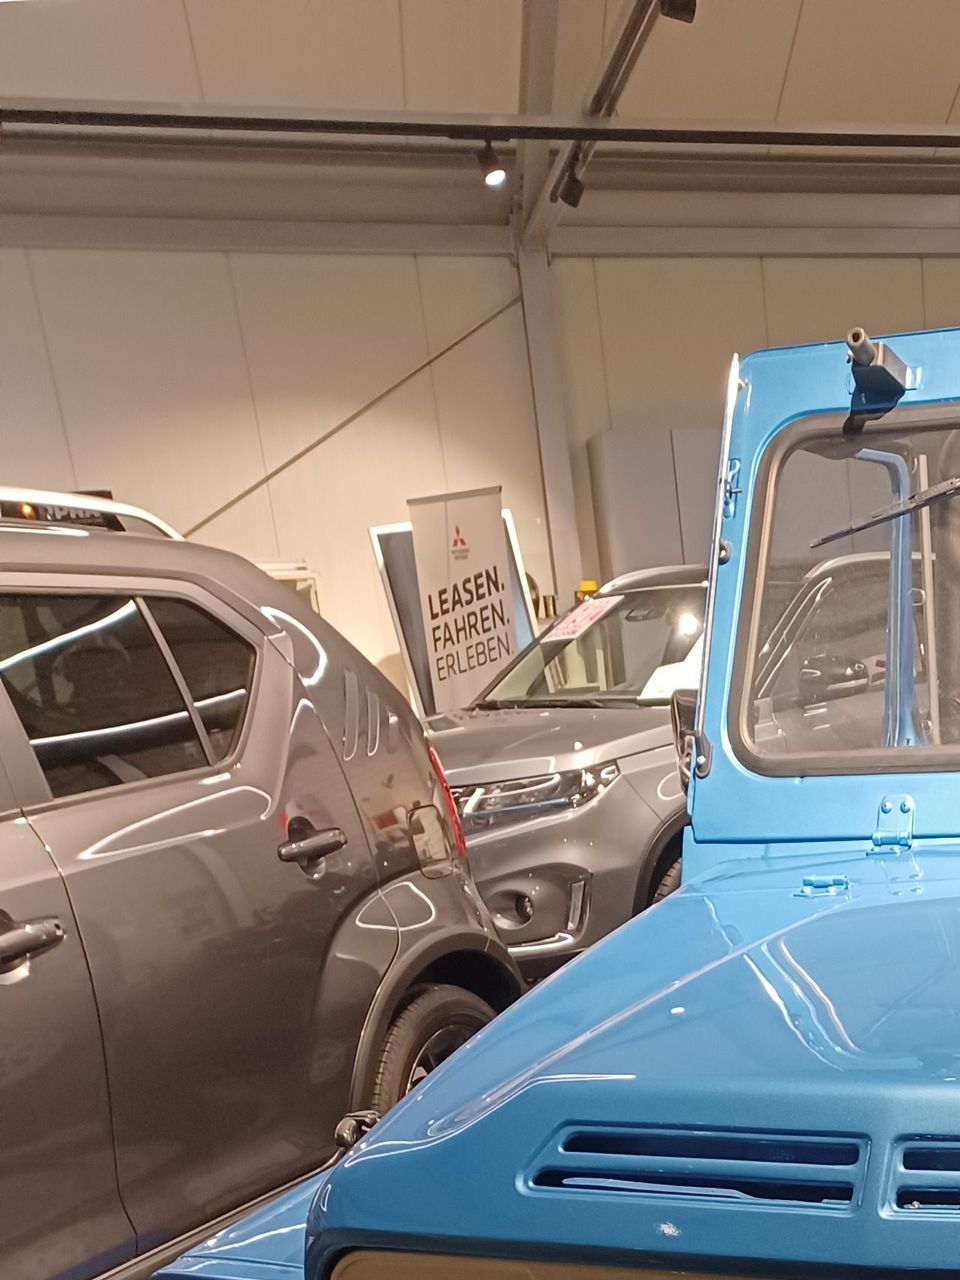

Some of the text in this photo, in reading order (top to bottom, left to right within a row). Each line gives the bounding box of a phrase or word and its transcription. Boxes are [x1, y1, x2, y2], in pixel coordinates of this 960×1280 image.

[428, 565, 505, 621] LEASEN.
[432, 599, 510, 653] FAHREN.
[436, 631, 515, 682] ERLEBEN.
